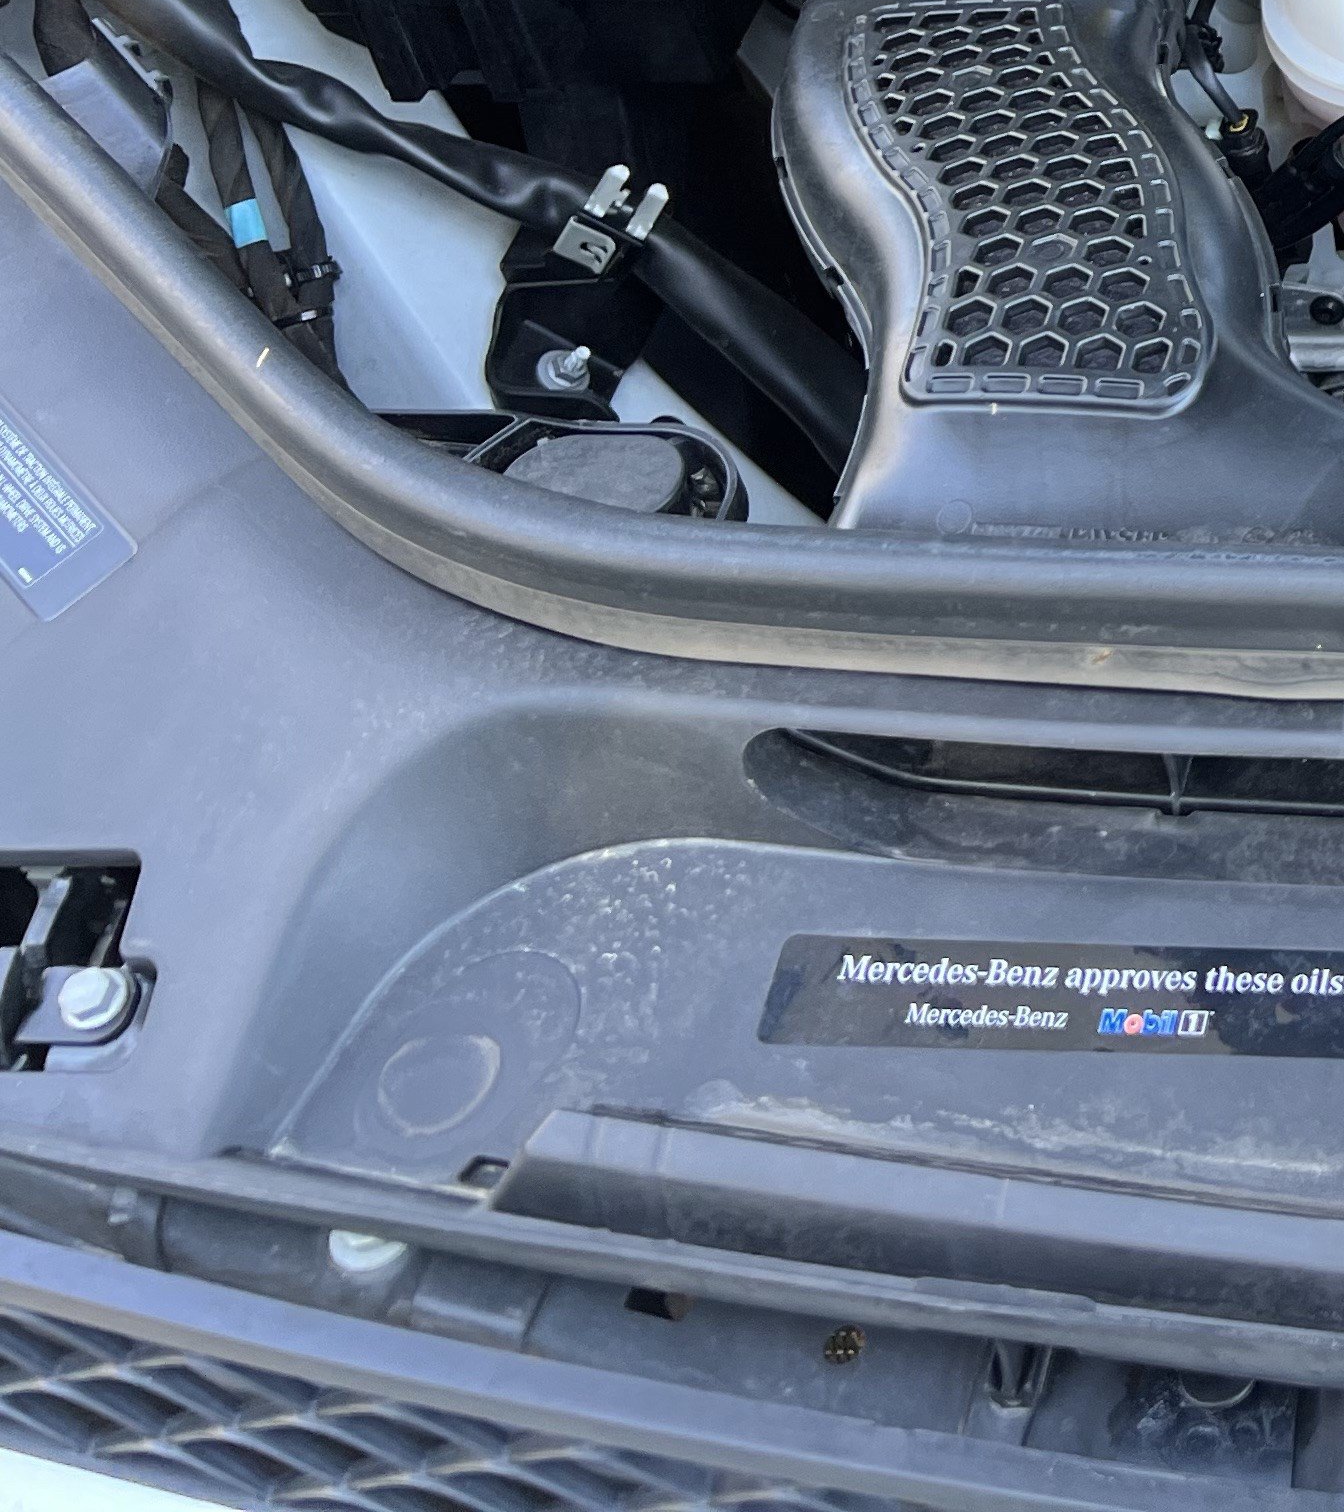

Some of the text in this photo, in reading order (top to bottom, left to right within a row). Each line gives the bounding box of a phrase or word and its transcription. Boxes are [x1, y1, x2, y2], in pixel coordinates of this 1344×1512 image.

[837, 954, 1059, 986] Mercedes-Benz
[1065, 966, 1197, 995] approves
[1205, 966, 1287, 992] these
[904, 1003, 1068, 1029] Mercedes-Benz
[1097, 1008, 1178, 1036] Mobil
